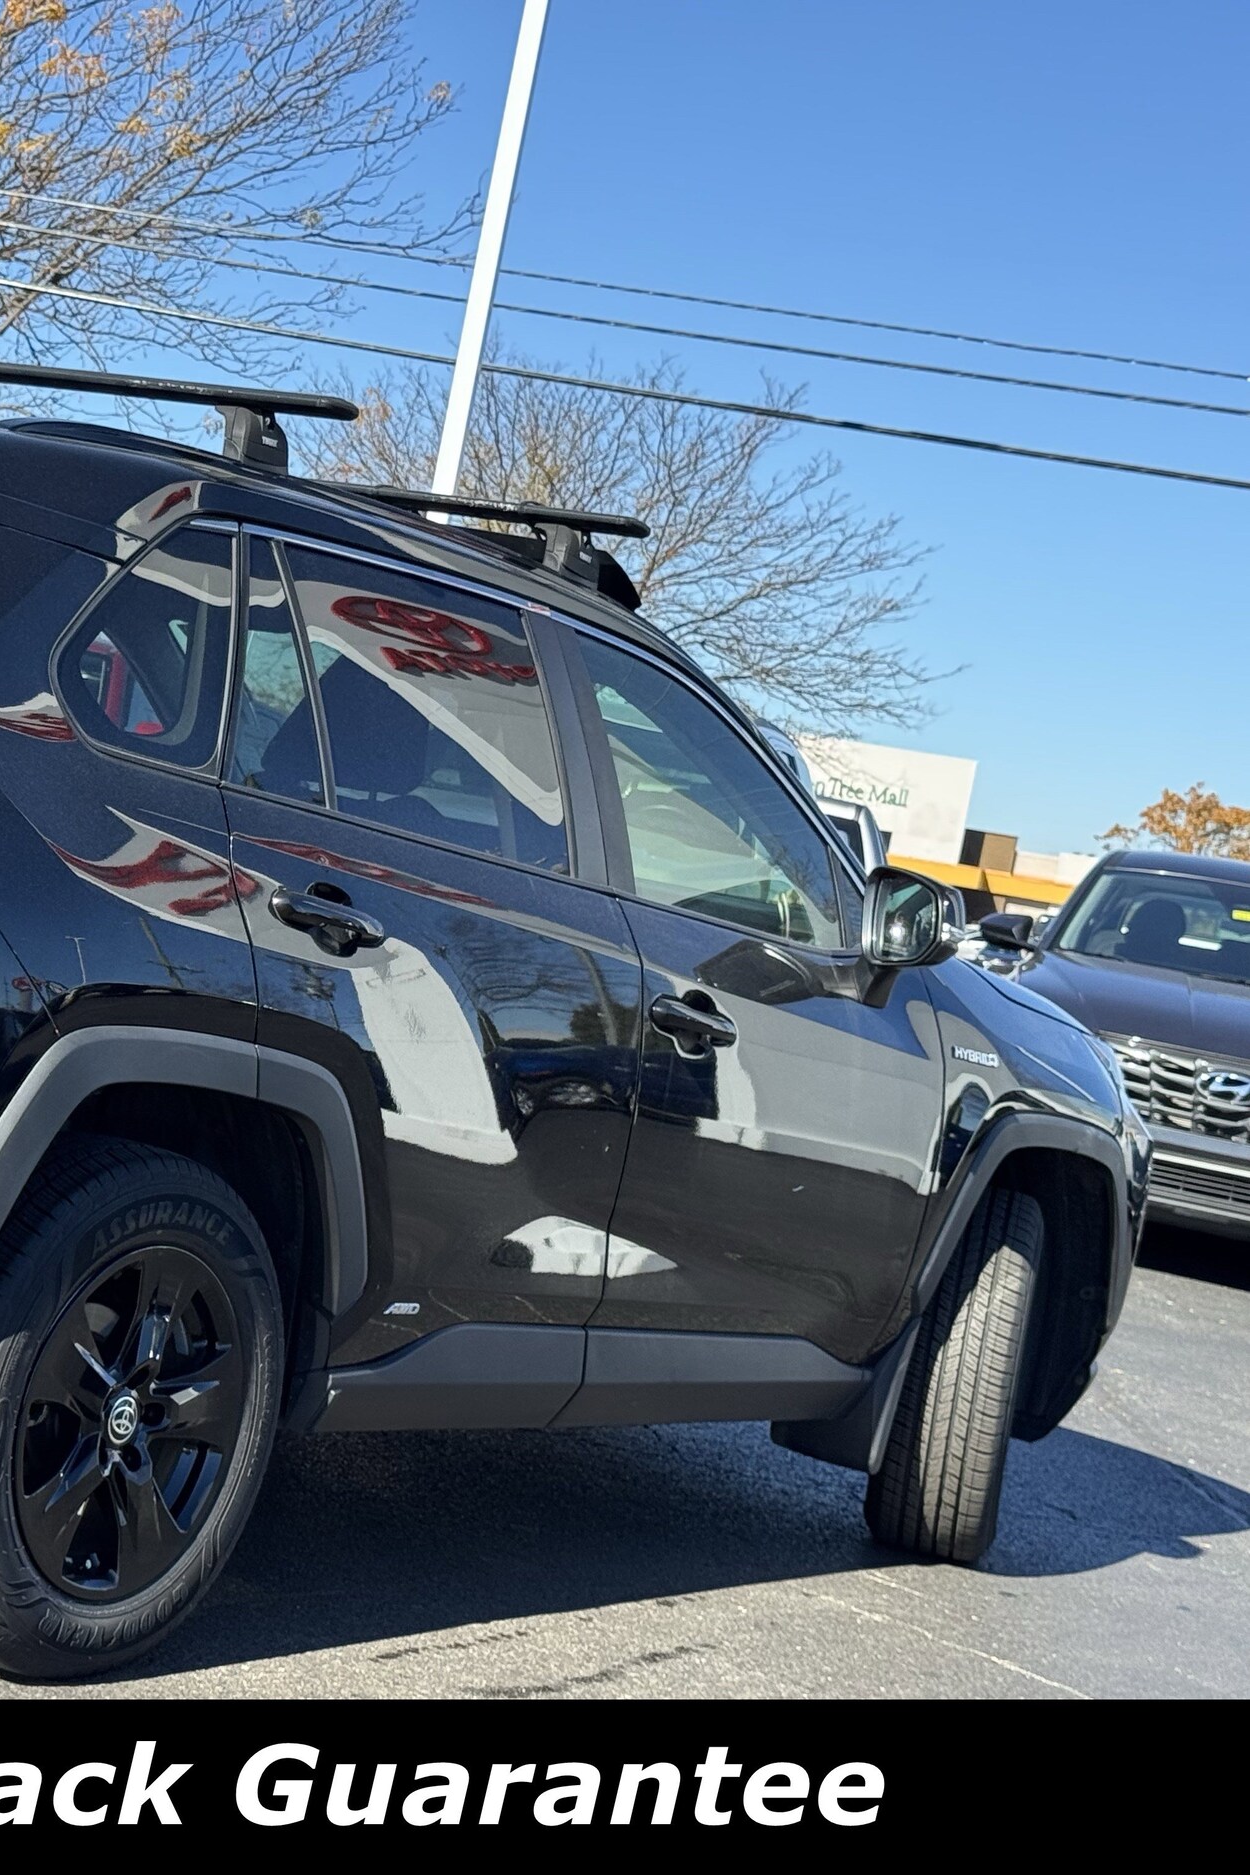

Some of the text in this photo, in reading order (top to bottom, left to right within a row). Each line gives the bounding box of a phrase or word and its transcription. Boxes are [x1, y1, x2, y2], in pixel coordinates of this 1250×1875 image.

[829, 776, 864, 800] Tree
[868, 784, 909, 807] Mall
[954, 1045, 991, 1067] HYBRID
[92, 1201, 235, 1257] ASSURANCE
